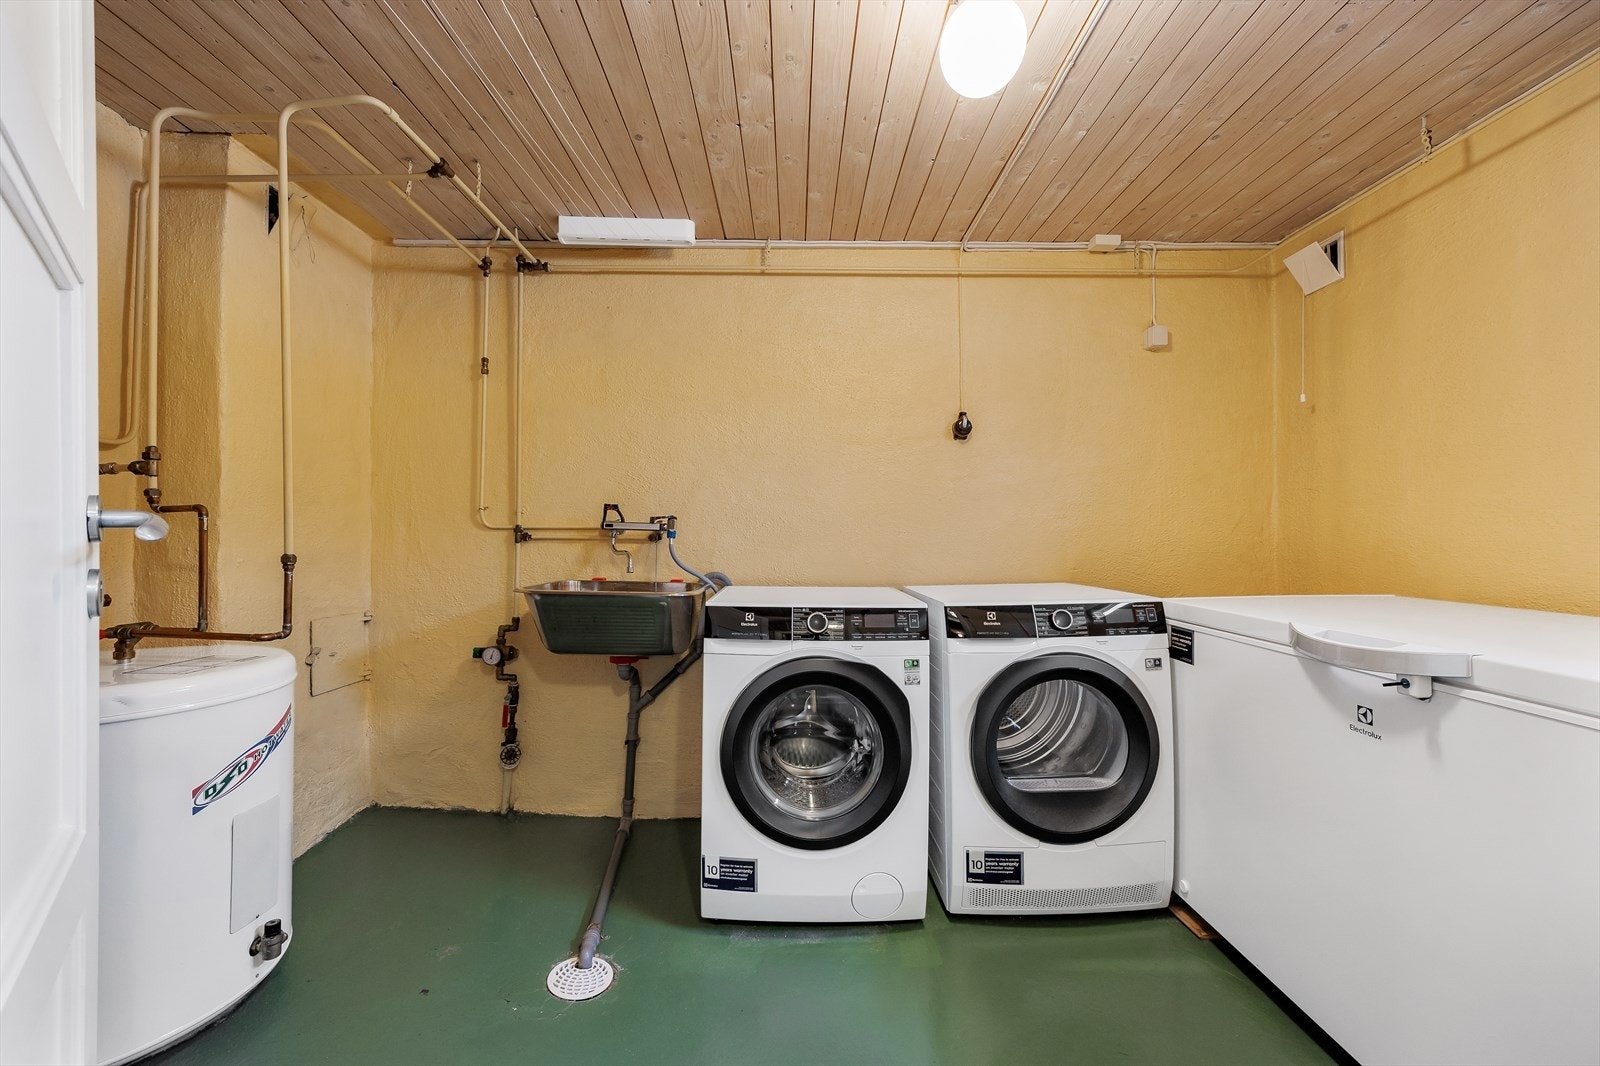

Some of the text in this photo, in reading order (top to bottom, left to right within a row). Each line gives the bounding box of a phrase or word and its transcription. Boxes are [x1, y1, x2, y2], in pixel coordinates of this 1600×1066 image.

[1350, 723, 1382, 741] Electrolux
[204, 759, 248, 801] OSO
[707, 865, 718, 875] 10
[971, 860, 983, 870] 10
